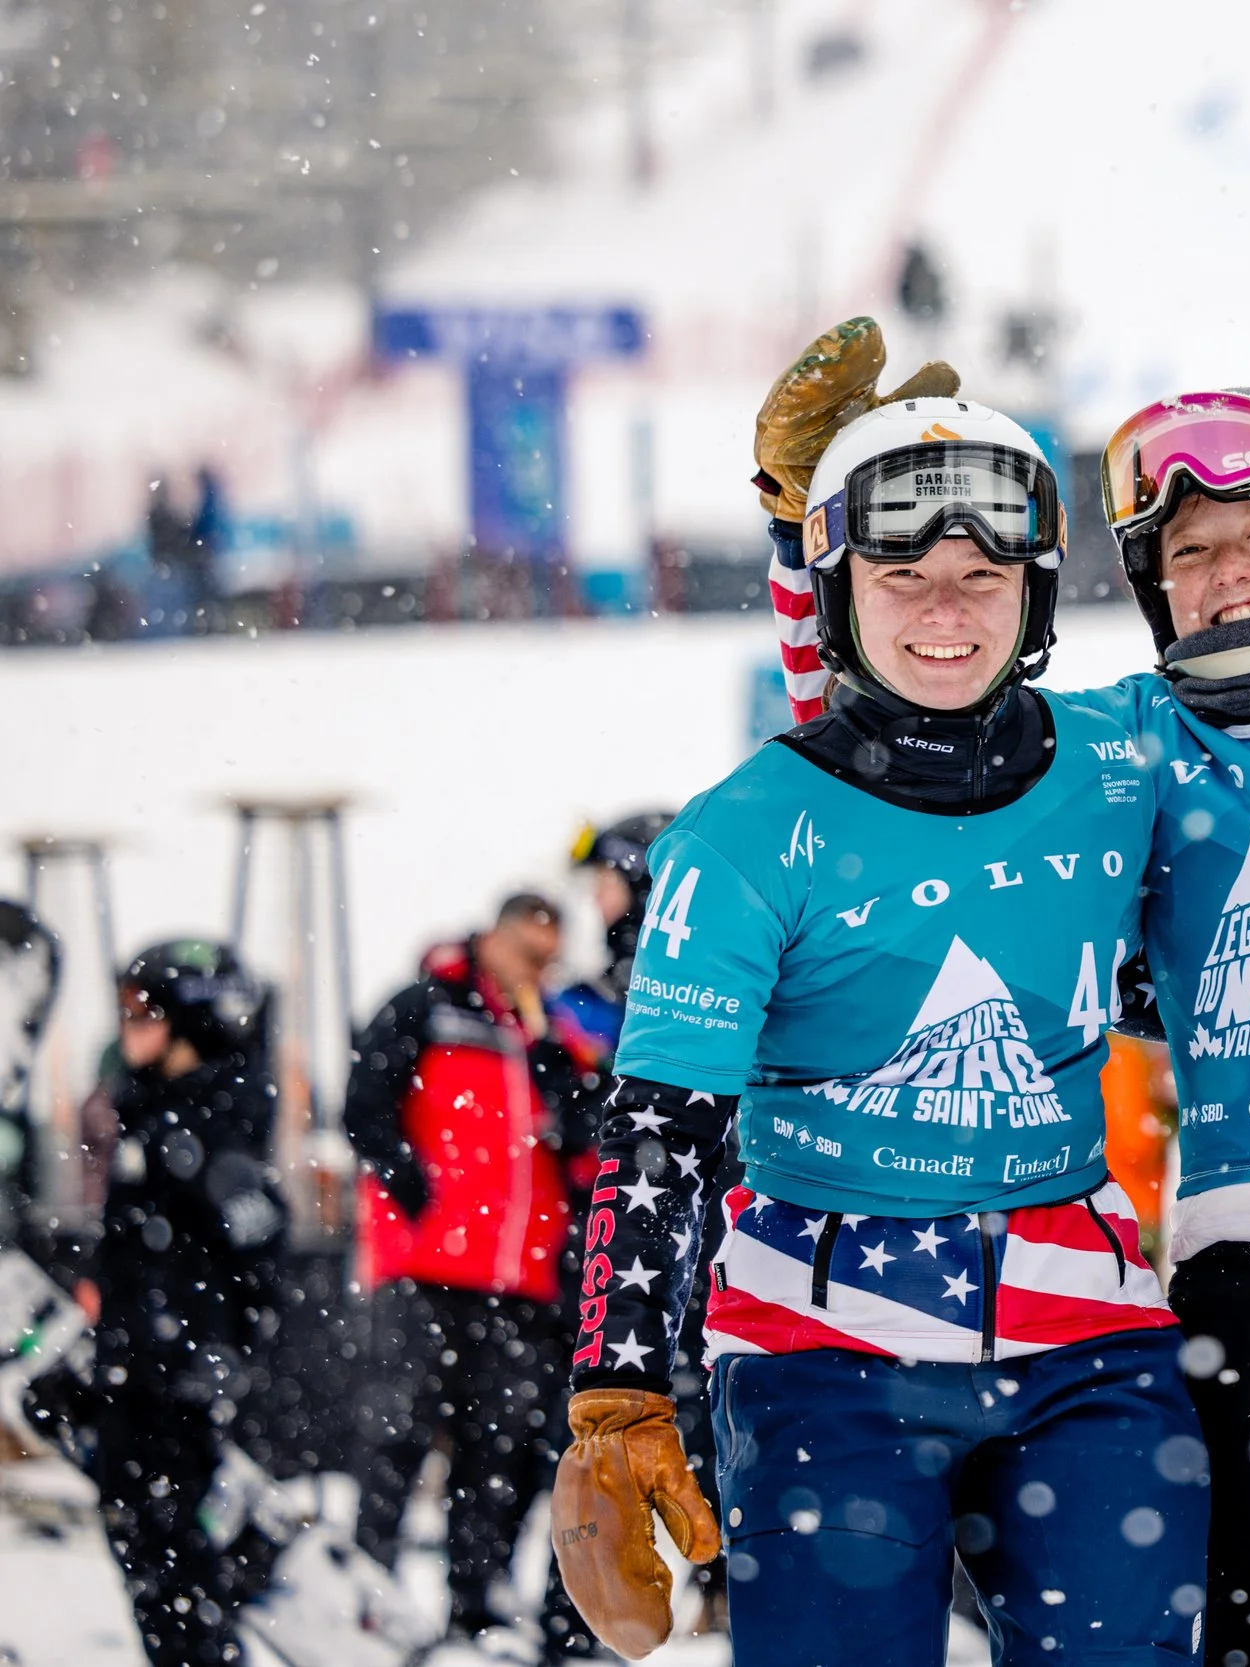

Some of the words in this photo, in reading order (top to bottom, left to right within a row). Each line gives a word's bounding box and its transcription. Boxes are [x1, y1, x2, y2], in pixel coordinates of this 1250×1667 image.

[915, 473, 971, 486] GARAGE
[915, 486, 971, 497] STRENGTH
[1086, 739, 1141, 761] VISA
[1102, 779, 1140, 789] SNOWBOARD
[1105, 787, 1126, 796] ALPINE
[836, 849, 1124, 929] VOLVO
[640, 858, 701, 960] 44
[1194, 964, 1226, 1017] DU
[671, 1009, 702, 1025] Vivez
[846, 1086, 900, 1118] VAL
[912, 1089, 1072, 1130] SAINT-CÔME
[773, 1116, 795, 1140] CAN
[815, 1136, 842, 1158] SBD
[872, 1146, 975, 1177] Canada
